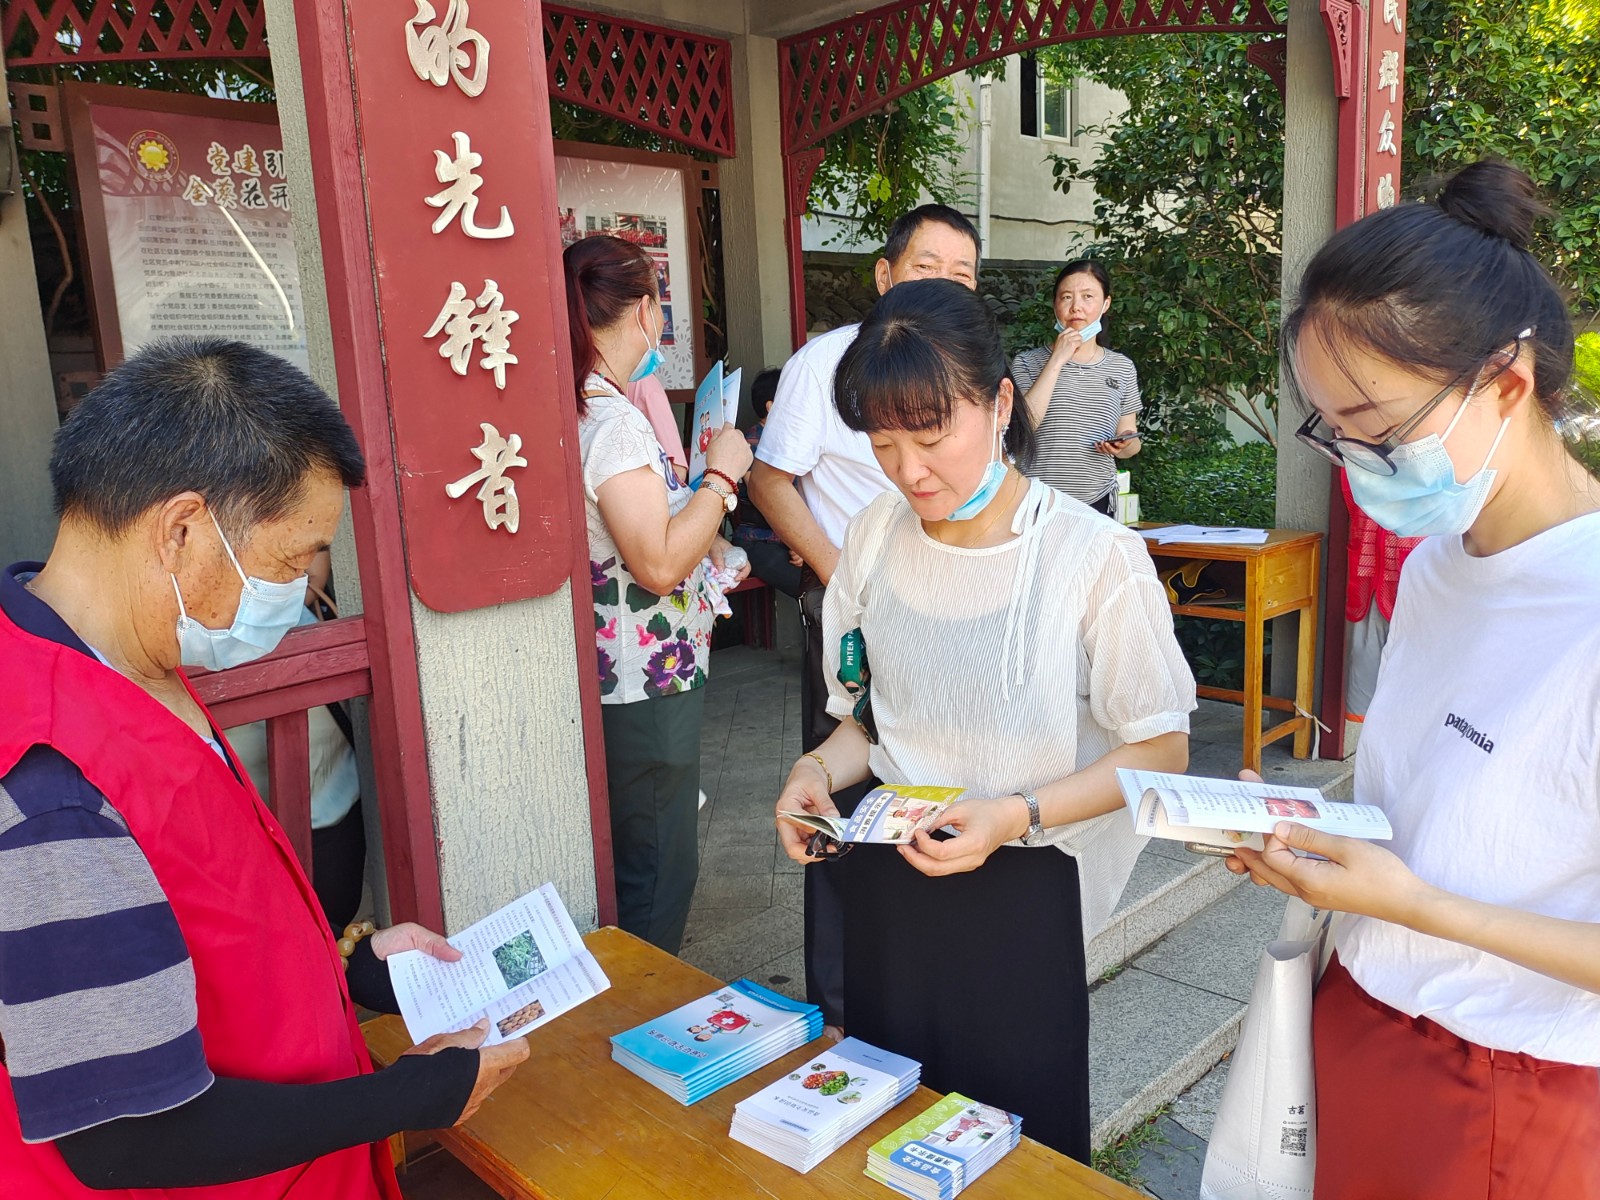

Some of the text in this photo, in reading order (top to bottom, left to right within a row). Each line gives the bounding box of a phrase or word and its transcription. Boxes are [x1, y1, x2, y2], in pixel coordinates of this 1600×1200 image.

[405, 0, 528, 535] 的先锋者
[902, 1155, 942, 1174] 食品安全
